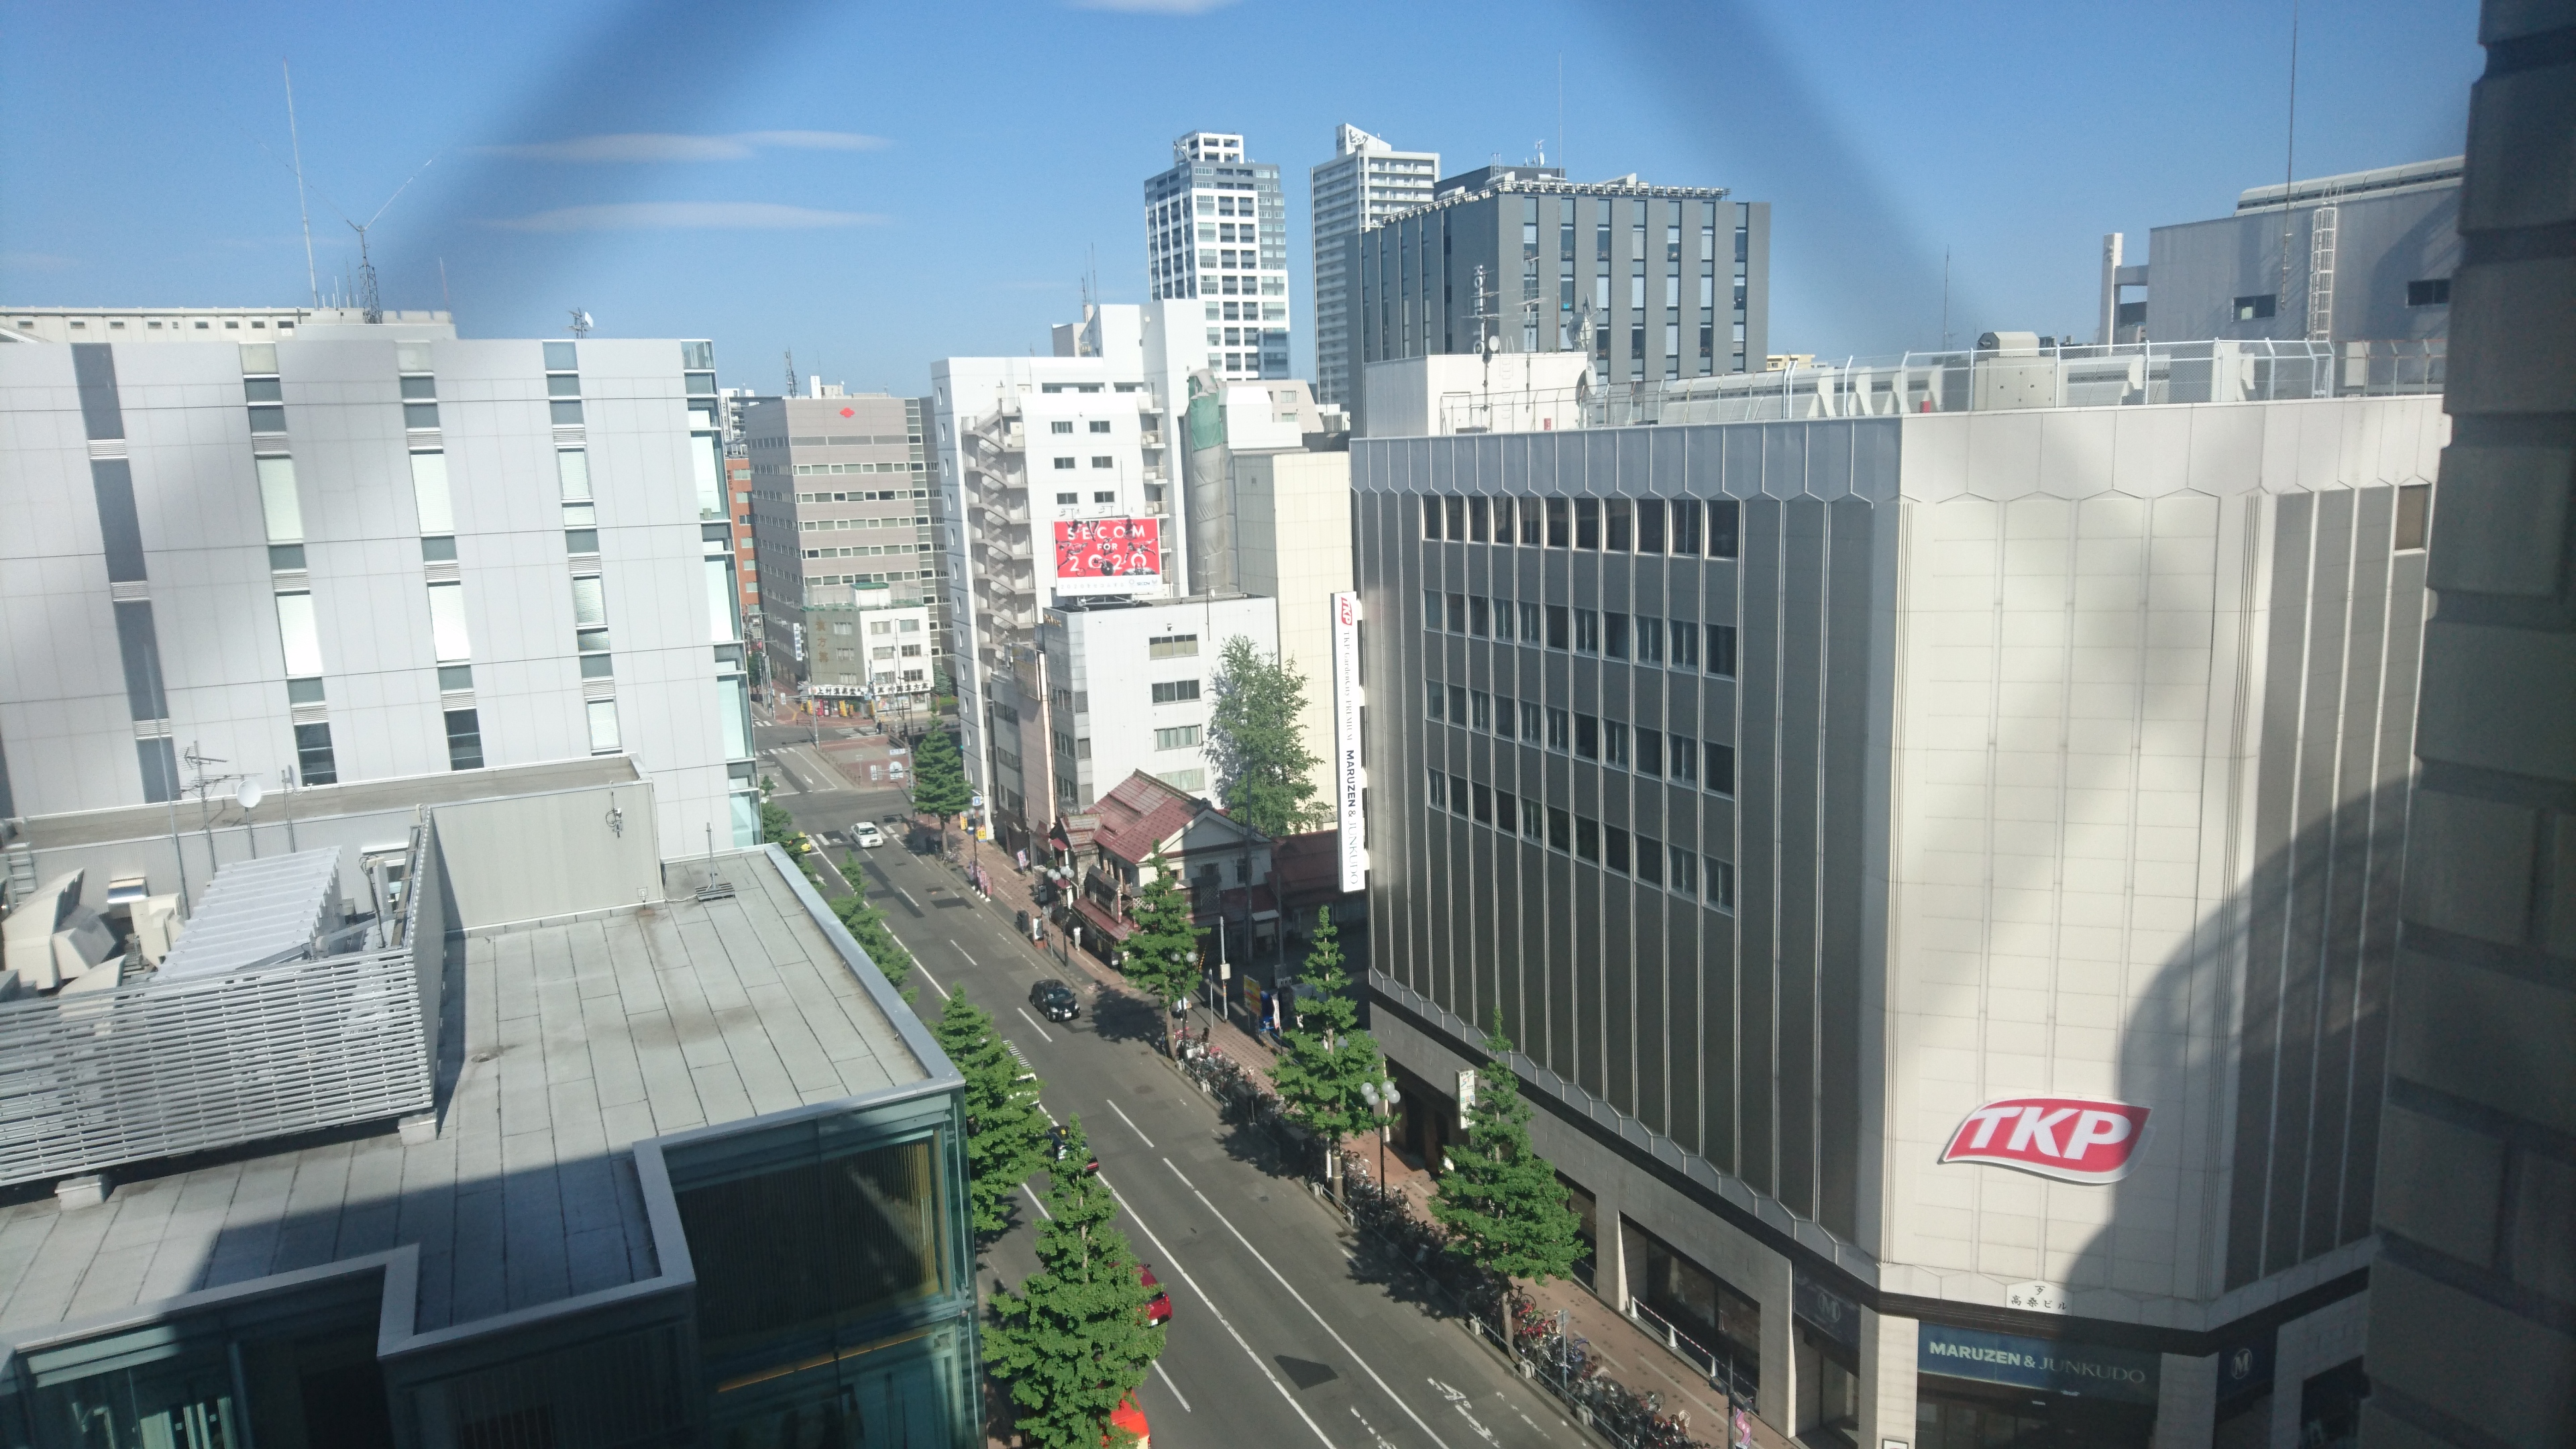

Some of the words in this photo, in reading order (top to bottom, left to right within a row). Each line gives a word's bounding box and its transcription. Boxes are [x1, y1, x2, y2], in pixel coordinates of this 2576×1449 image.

[1068, 525, 1145, 540] SECOM
[1097, 543, 1118, 551] FOR
[1069, 553, 1147, 572] 2020
[1341, 597, 1352, 625] TKP
[1346, 749, 1356, 808] MARUZEN
[1348, 810, 1356, 818] &
[1348, 821, 1358, 884] JUNKUDO
[1968, 1106, 2133, 1161] TKP
[2011, 1295, 2067, 1310] 高桑ビル
[1929, 1341, 2021, 1366] MARUZEN
[2024, 1355, 2036, 1368] &
[2039, 1356, 2145, 1384] JUNKUDO
